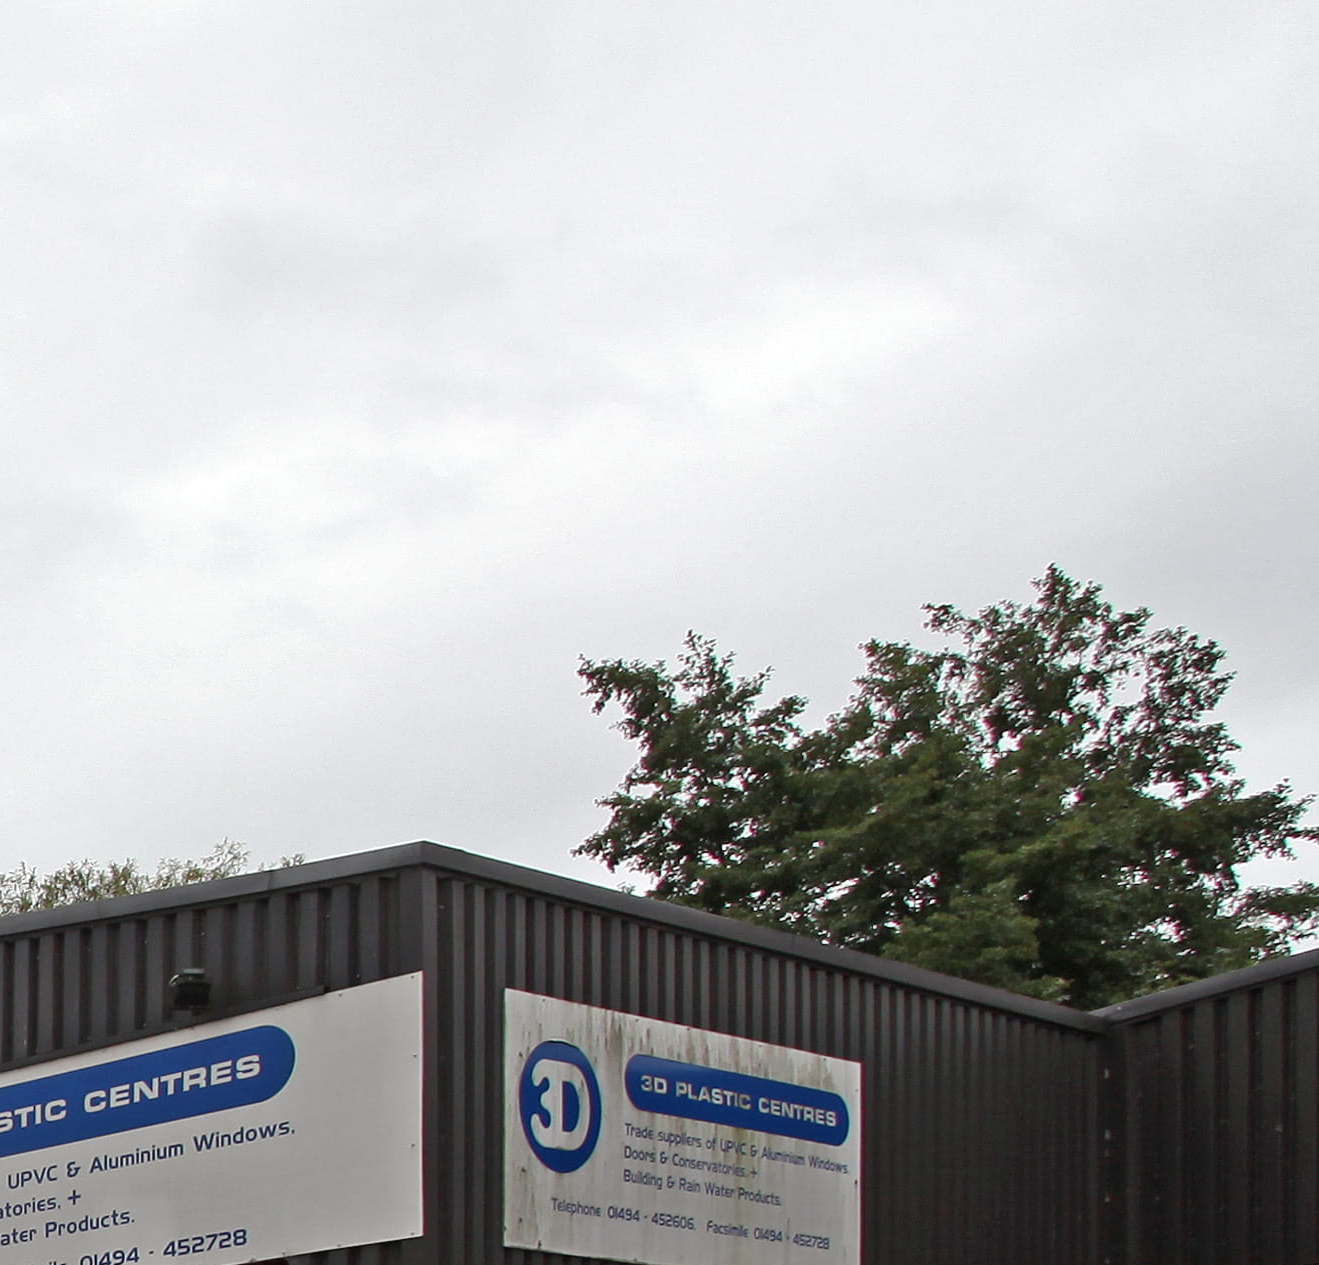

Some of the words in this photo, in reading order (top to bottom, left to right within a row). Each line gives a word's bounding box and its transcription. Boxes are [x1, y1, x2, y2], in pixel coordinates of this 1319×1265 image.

[84, 1054, 260, 1113] CENTRES
[530, 1058, 591, 1151] 3D
[640, 1075, 668, 1095] 3D
[675, 1081, 752, 1110] PLASTIC
[758, 1097, 837, 1127] CENTRES
[7, 1165, 58, 1190] UPVC
[66, 1162, 81, 1177] &
[90, 1142, 184, 1173] Aluminium
[193, 1120, 295, 1152] Windows.
[624, 1123, 654, 1140] Trade
[657, 1132, 702, 1149] suppliers
[706, 1139, 717, 1150] of
[720, 1140, 746, 1156] UPVC
[761, 1147, 805, 1166] Aluminium
[624, 1146, 656, 1163] Doors
[623, 1169, 663, 1190] Building
[679, 1178, 701, 1193] Rain
[704, 1182, 734, 1199] Water
[45, 1209, 135, 1238] Products.
[163, 1228, 248, 1257] 452728
[551, 1197, 601, 1218] Telephone
[607, 1206, 640, 1222] 01494
[707, 1220, 749, 1239] Facsimile
[754, 1227, 783, 1242] 01494
[793, 1233, 830, 1250] 452728
